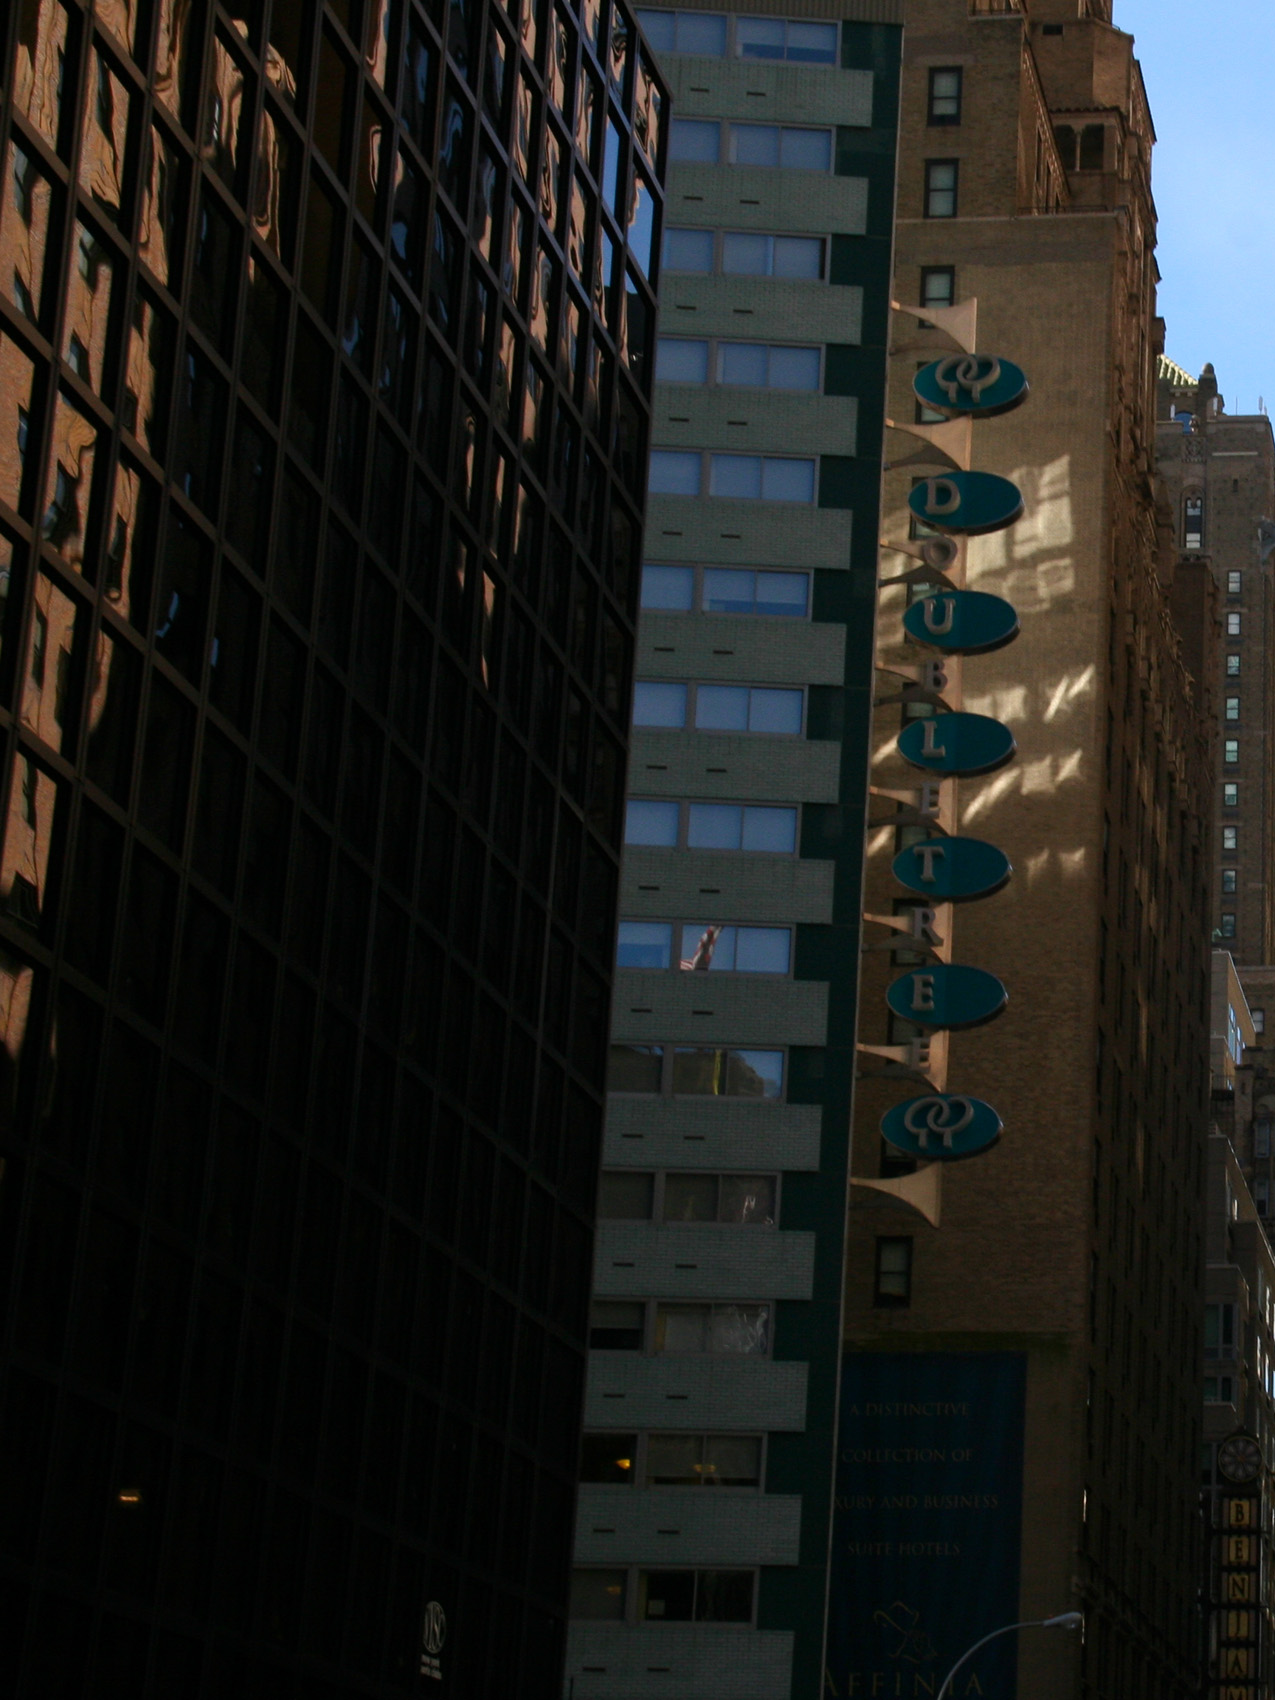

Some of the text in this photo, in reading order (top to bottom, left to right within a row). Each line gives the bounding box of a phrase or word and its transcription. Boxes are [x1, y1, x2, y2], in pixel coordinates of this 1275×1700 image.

[910, 477, 962, 1073] DOUBLETREE
[849, 1401, 970, 1417] A DISTINCTIVE
[841, 1448, 974, 1463] COLLECTION OF
[834, 1493, 999, 1510] XURY AND BUSINESS
[848, 1541, 962, 1556] SUITE HOTELS
